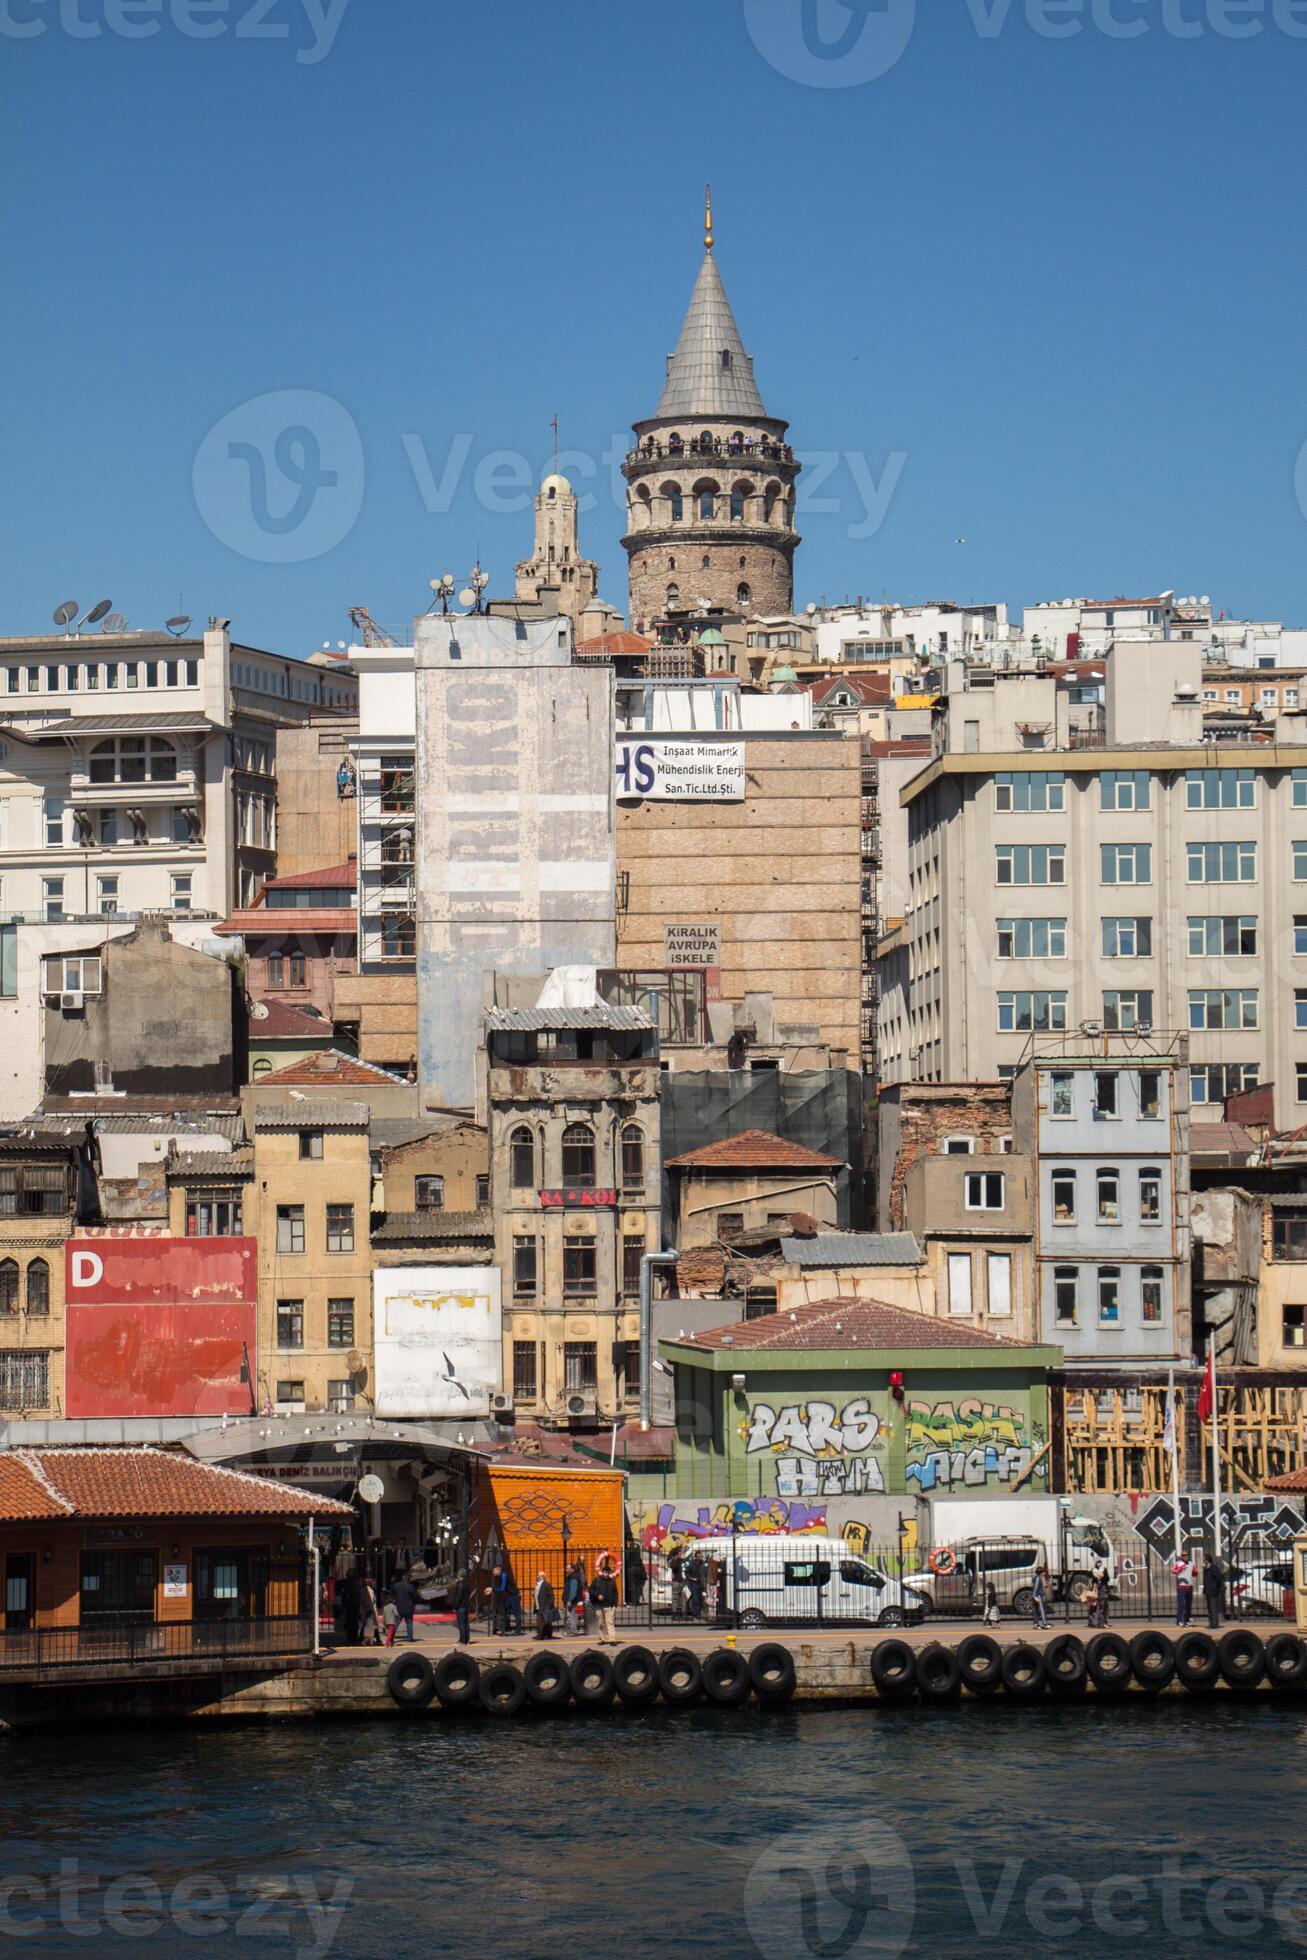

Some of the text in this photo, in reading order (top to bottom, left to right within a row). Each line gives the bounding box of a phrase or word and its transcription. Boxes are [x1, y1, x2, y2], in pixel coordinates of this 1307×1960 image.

[657, 764, 744, 777] Mühendislik Enerji
[668, 941, 717, 950] AVRUPA
[746, 1397, 880, 1457] PARS
